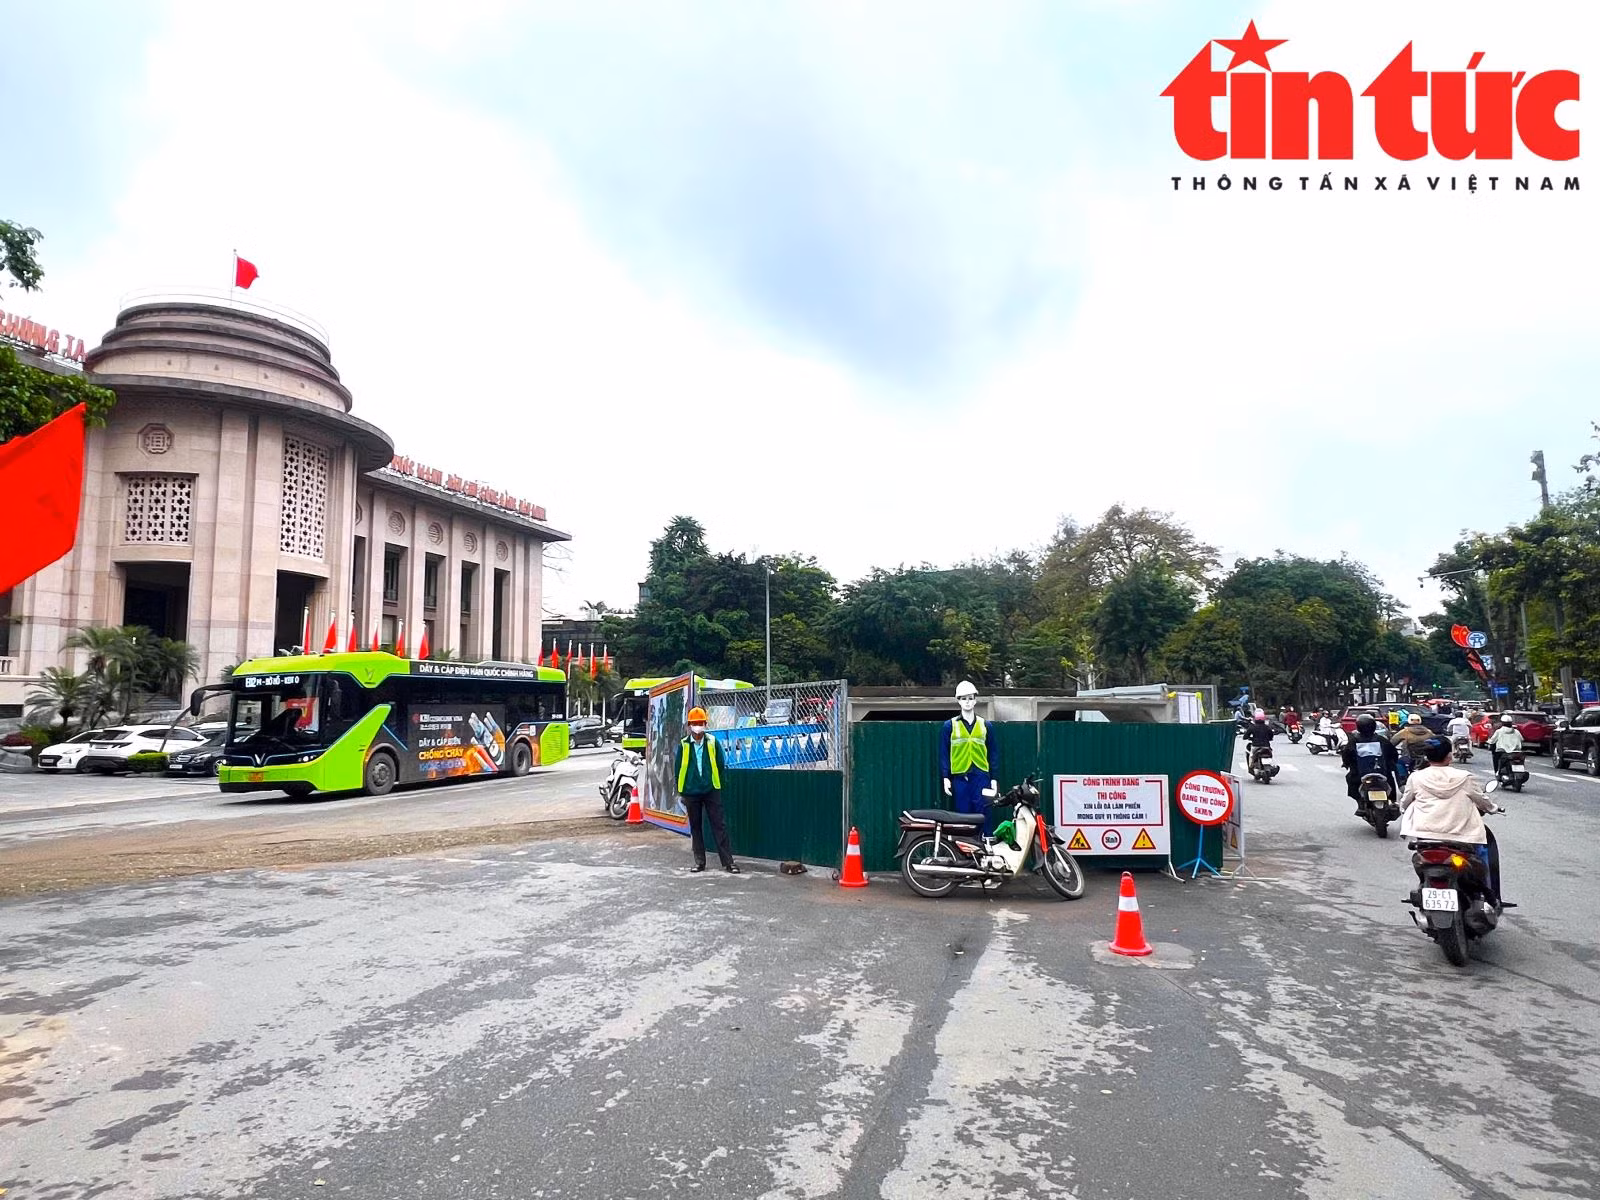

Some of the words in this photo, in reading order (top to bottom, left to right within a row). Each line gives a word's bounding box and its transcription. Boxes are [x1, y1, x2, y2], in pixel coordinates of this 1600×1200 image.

[1082, 777, 1101, 787] CÔNG
[1102, 777, 1121, 787] TRÌNH
[1184, 782, 1201, 792] CÔNG
[1097, 791, 1107, 800] THI
[1108, 790, 1127, 800] CÔNG
[1199, 796, 1209, 804] THI
[1209, 798, 1227, 808] CÔNG
[1113, 812, 1131, 820] THÔNG
